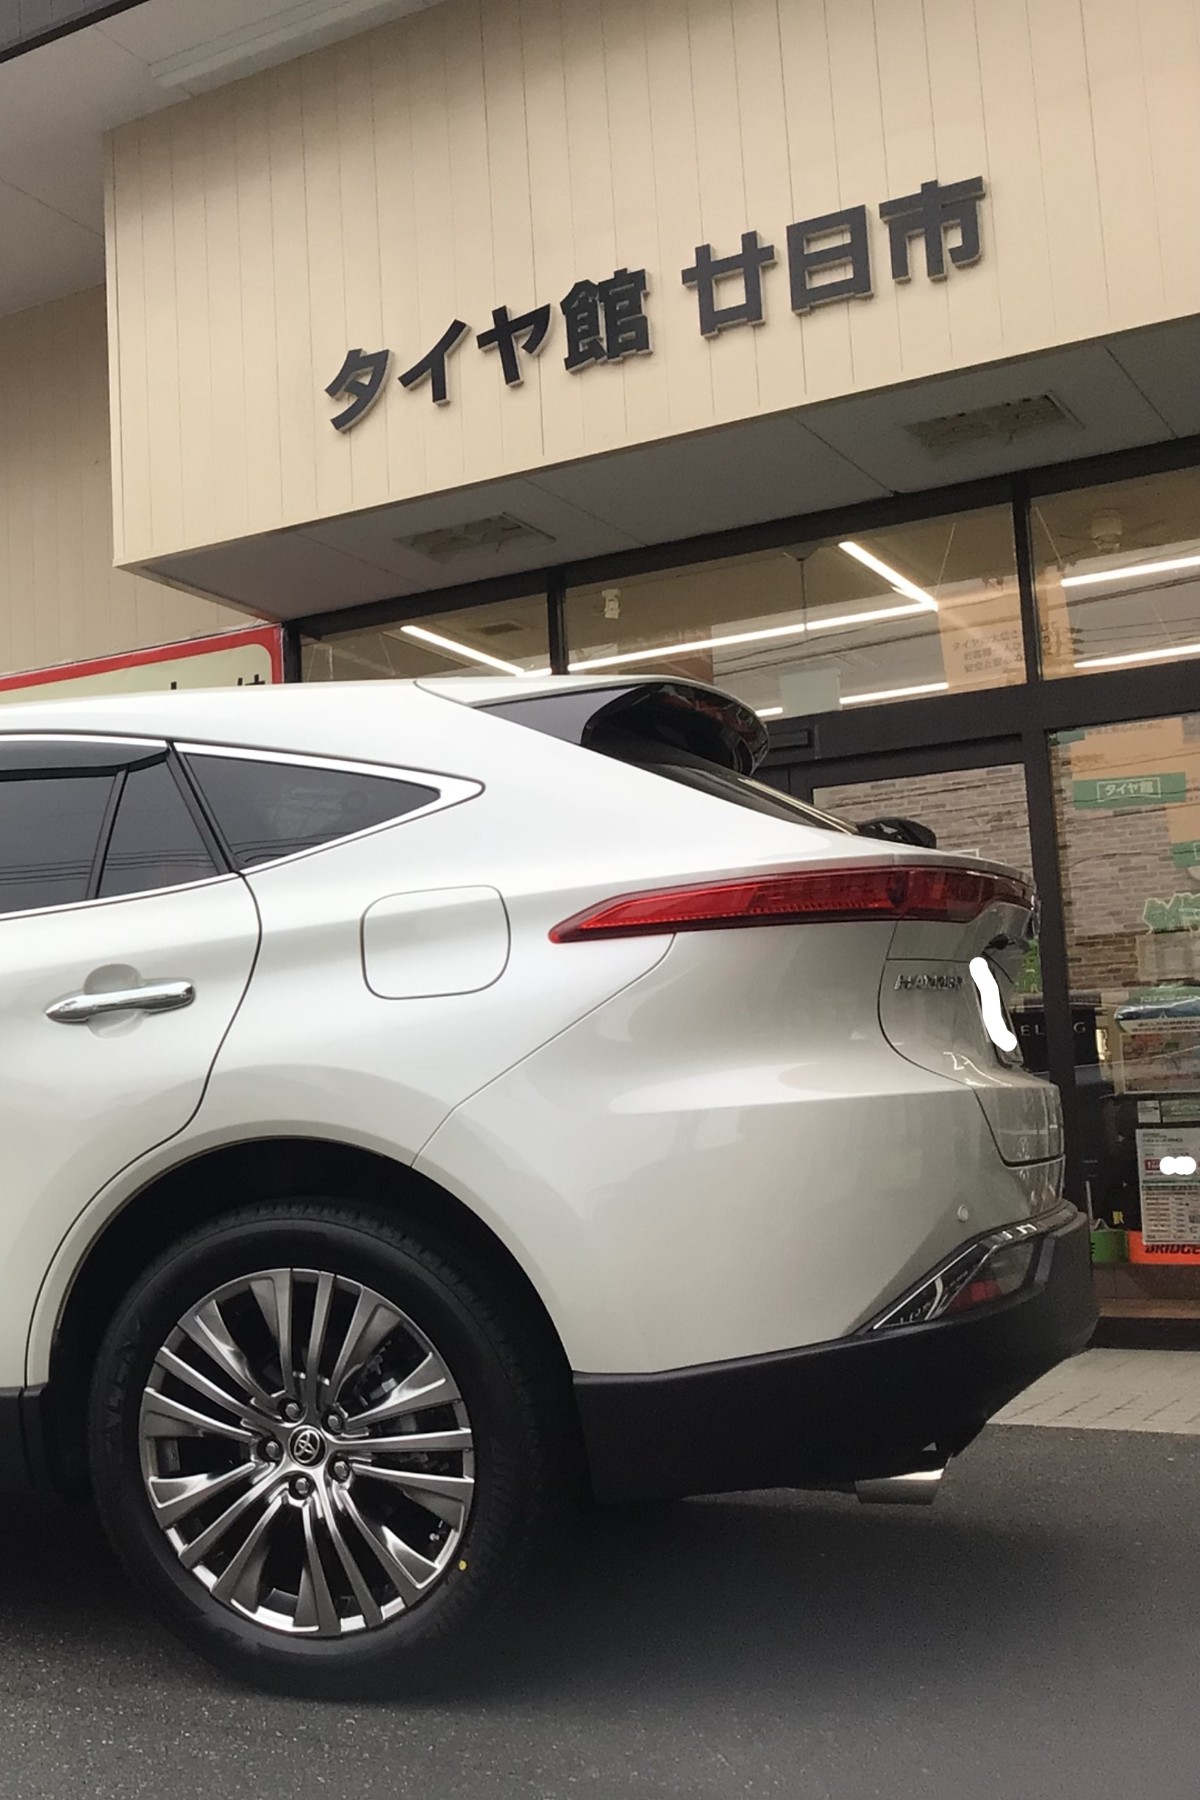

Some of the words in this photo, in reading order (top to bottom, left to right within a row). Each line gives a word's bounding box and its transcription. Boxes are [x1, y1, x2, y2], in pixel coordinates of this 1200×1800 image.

[324, 267, 655, 434] タイヤ館
[681, 175, 987, 339] 廿日市
